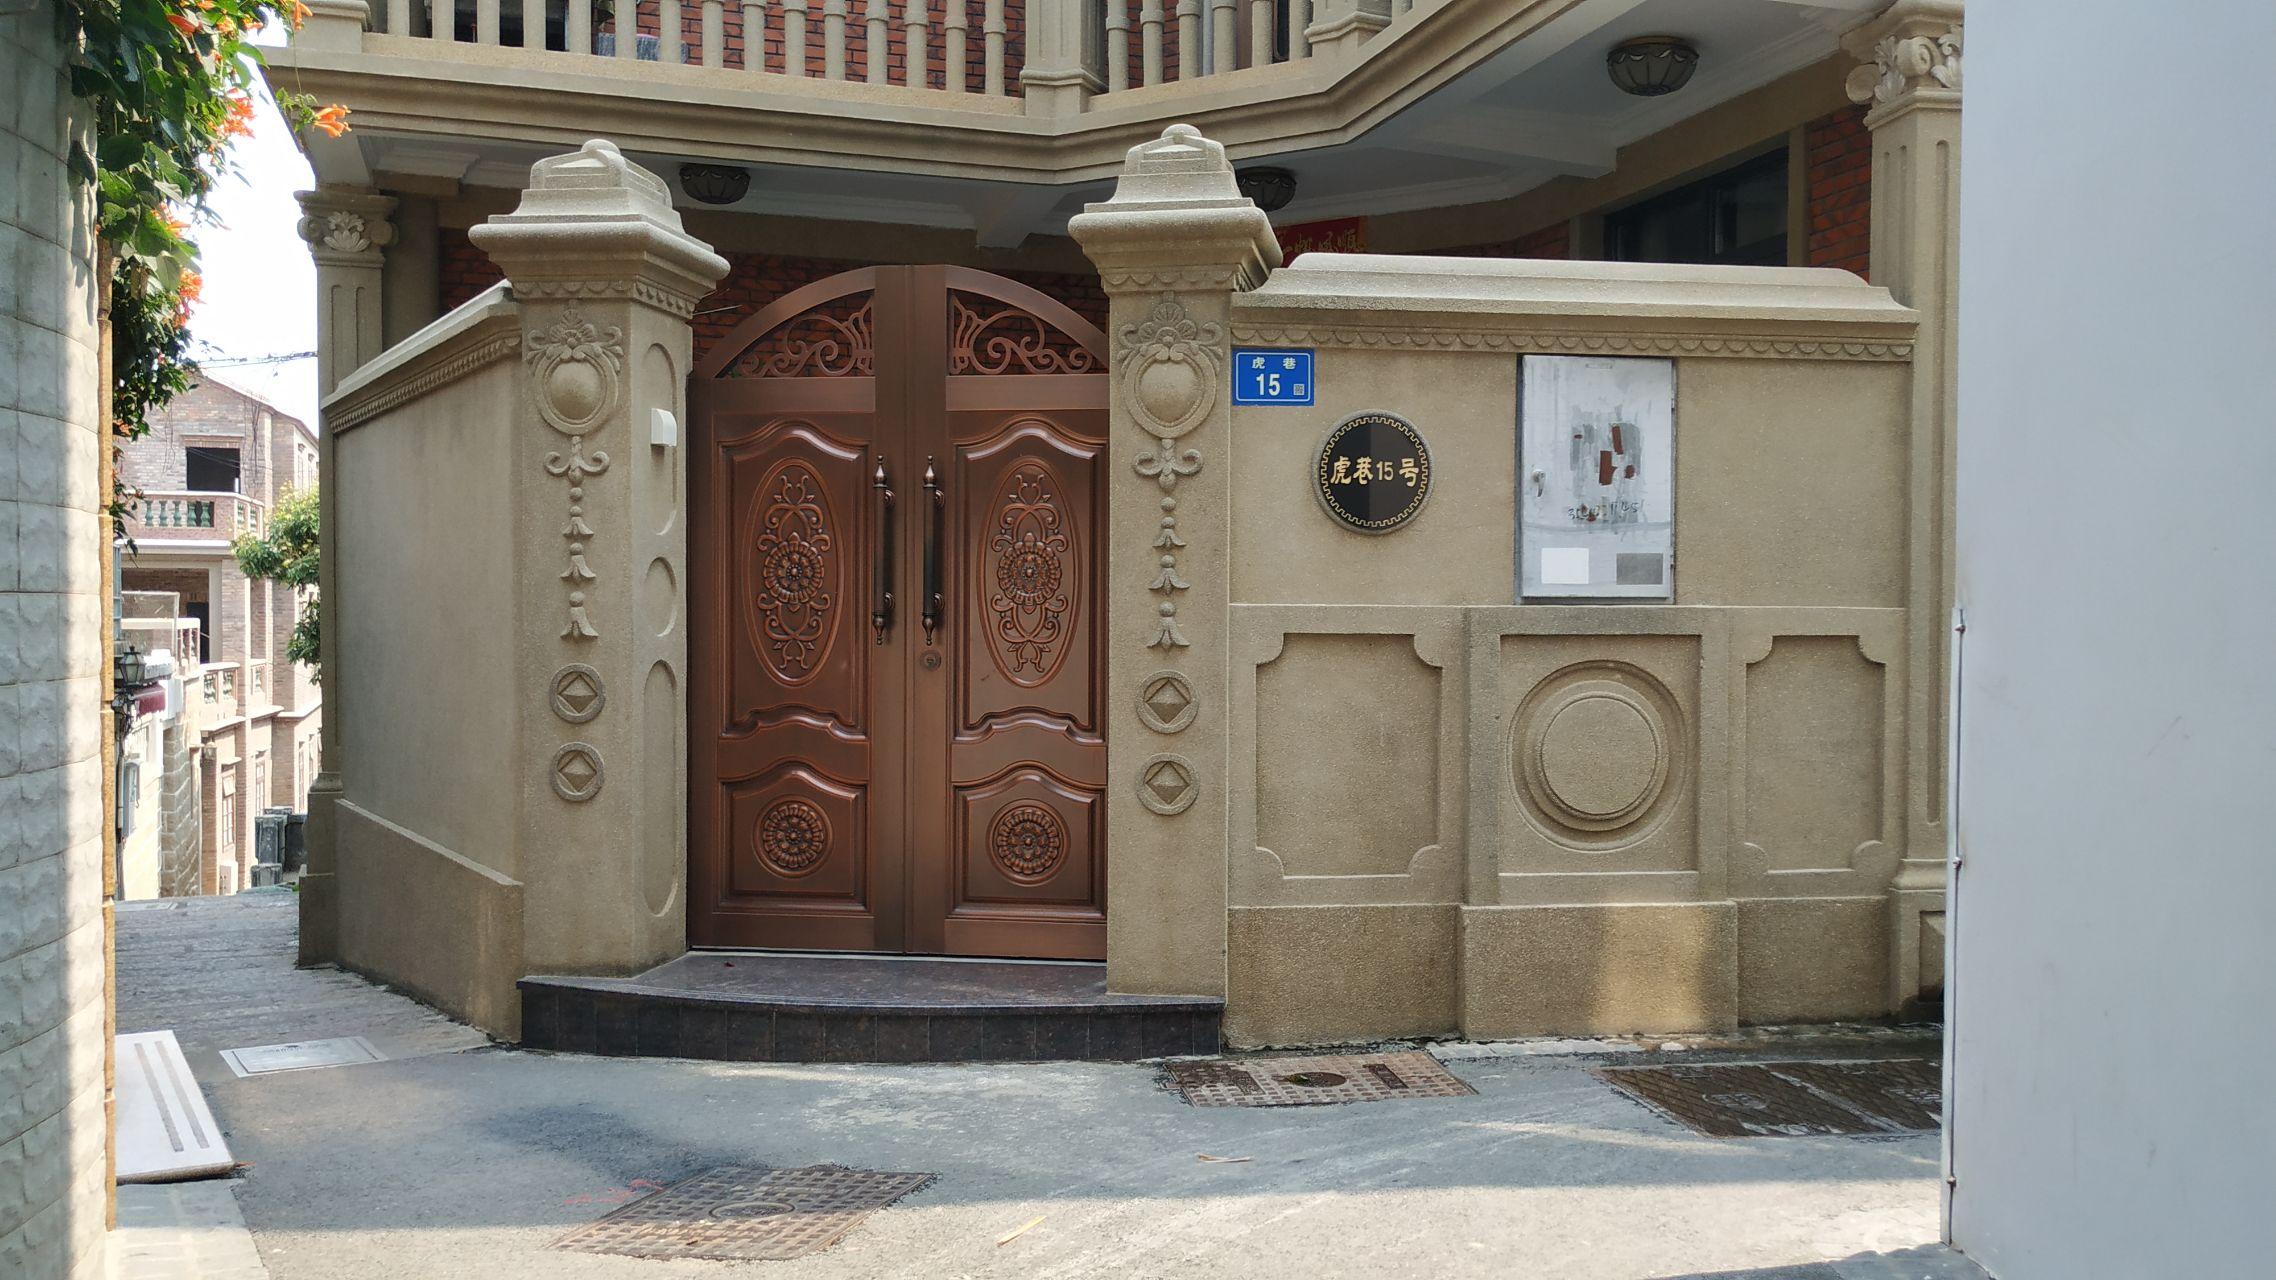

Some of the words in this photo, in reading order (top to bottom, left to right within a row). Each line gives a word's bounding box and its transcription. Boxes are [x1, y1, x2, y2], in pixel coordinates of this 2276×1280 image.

[1251, 356, 1296, 370] 虎巷
[1256, 373, 1280, 396] 15
[1330, 456, 1420, 487] 虎巷15号
